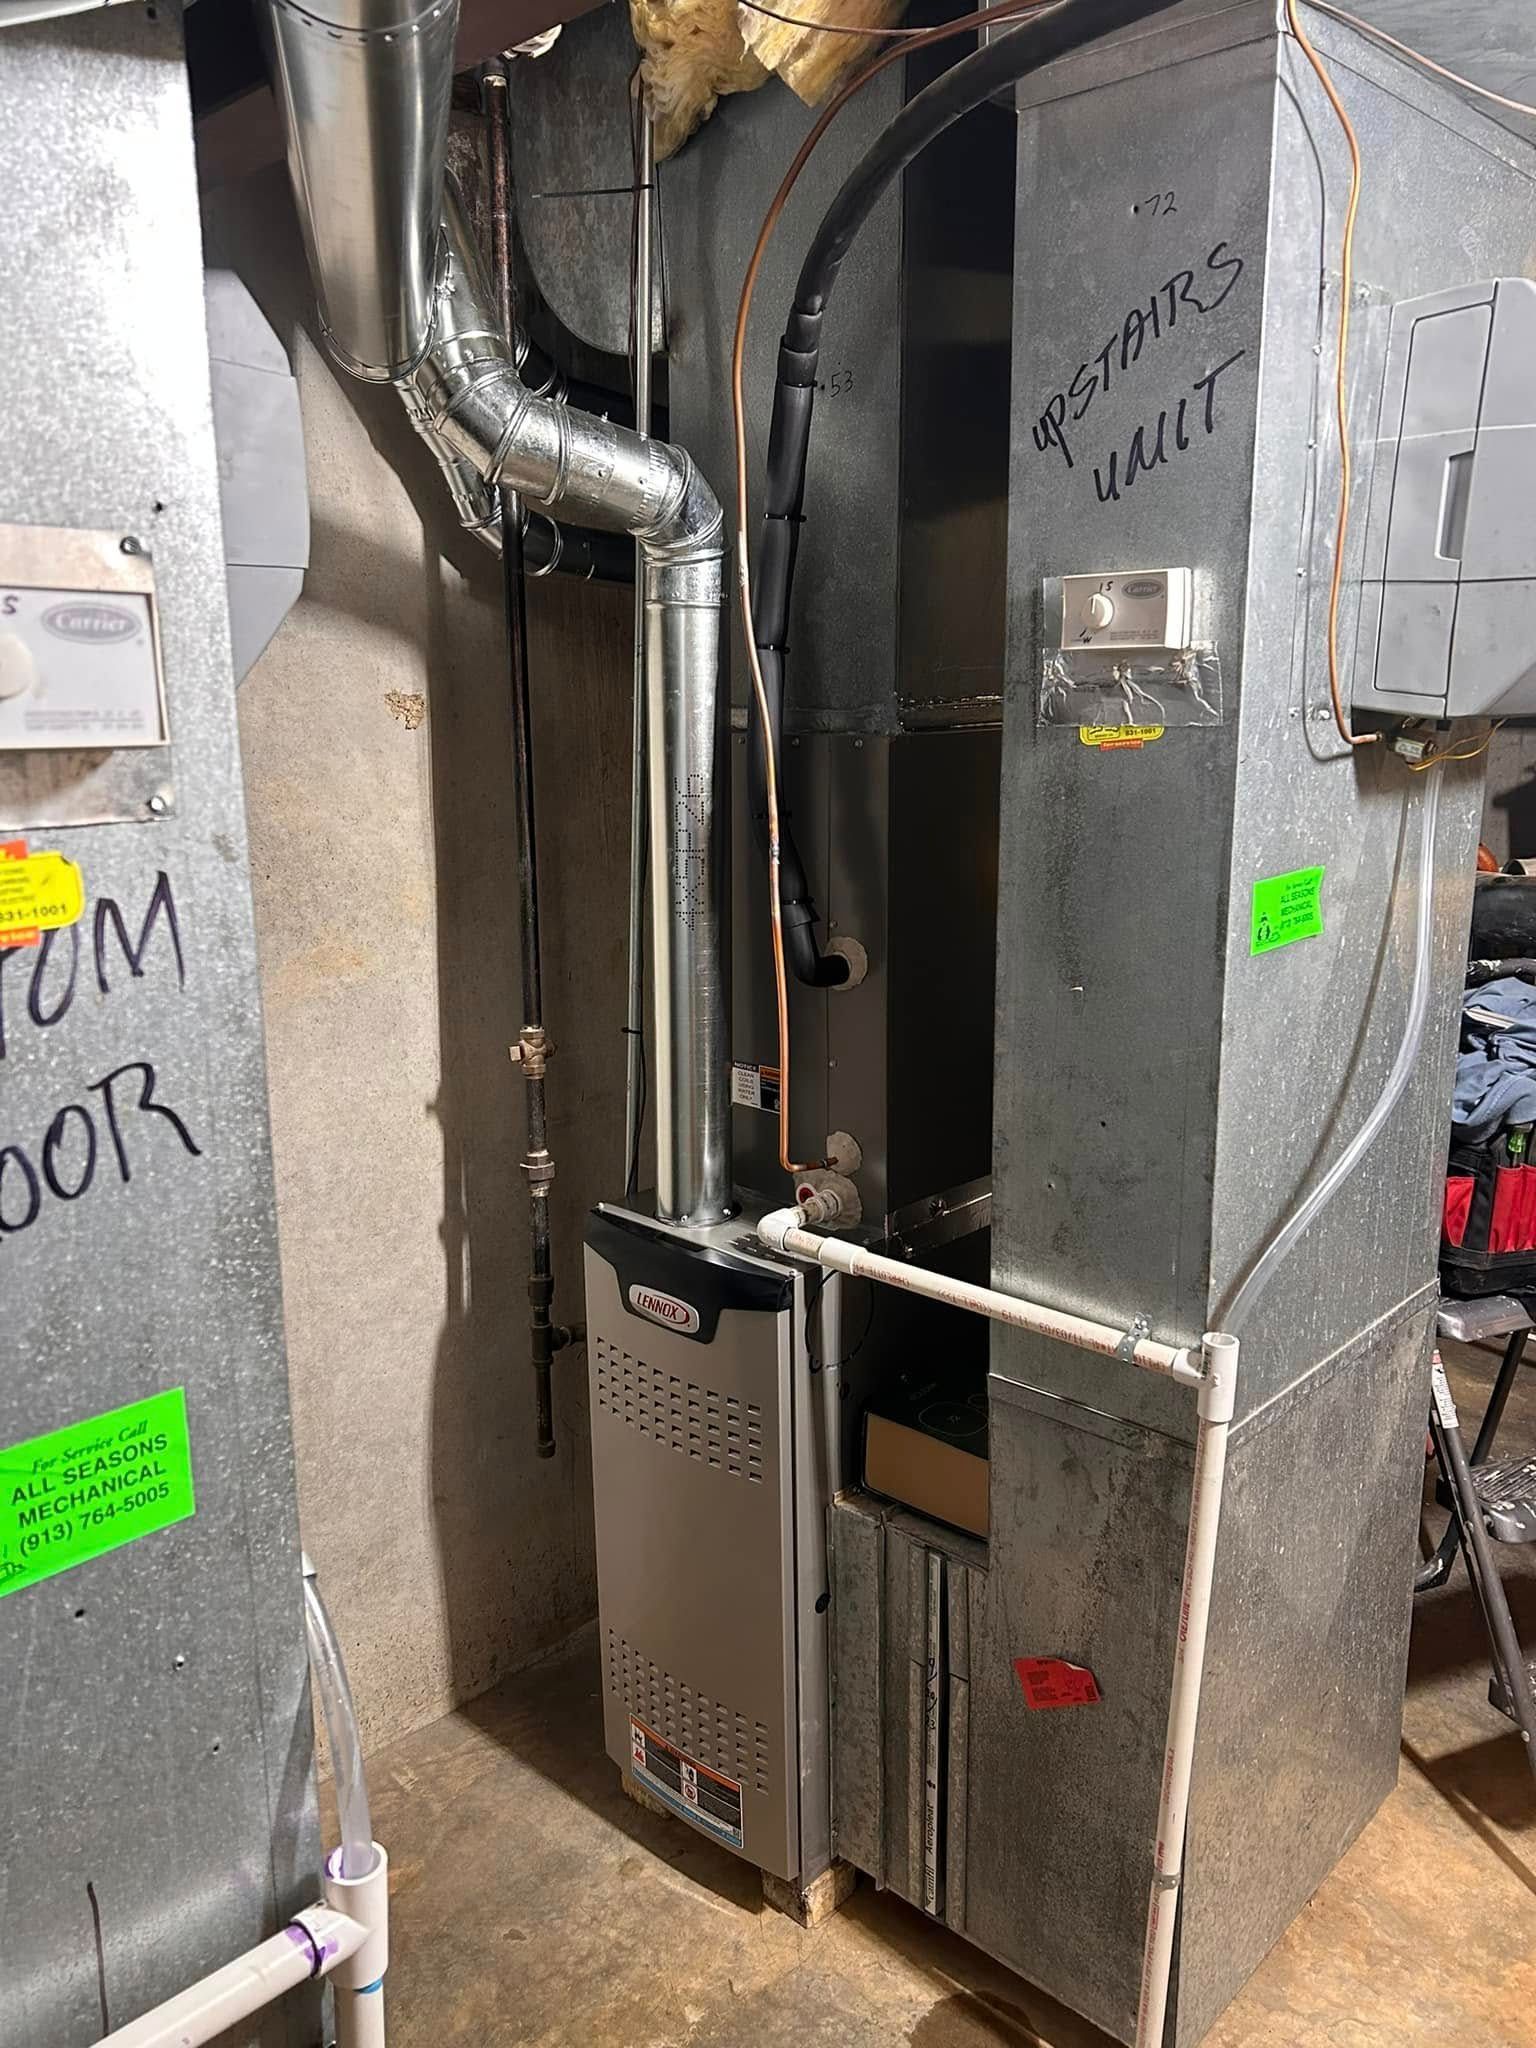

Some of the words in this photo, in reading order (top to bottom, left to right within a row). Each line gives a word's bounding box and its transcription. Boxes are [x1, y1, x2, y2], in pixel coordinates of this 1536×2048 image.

[1145, 191, 1178, 216] 72
[1032, 242, 1244, 468] UPSTAIRS
[831, 370, 853, 397] 53
[1093, 350, 1246, 502] UNIT
[53, 609, 131, 635] Carrier
[637, 1292, 679, 1320] LENNOX
[10, 1477, 57, 1506] ALL
[62, 1433, 169, 1486] SEASONS
[32, 1458, 58, 1476] For
[62, 1437, 114, 1465] Service
[117, 1420, 149, 1442] Call
[18, 1460, 168, 1530] MECHANICAL
[19, 1520, 74, 1558] (913)
[79, 1481, 171, 1531] 764-5005
[925, 1801, 936, 1855] Aeropleat
